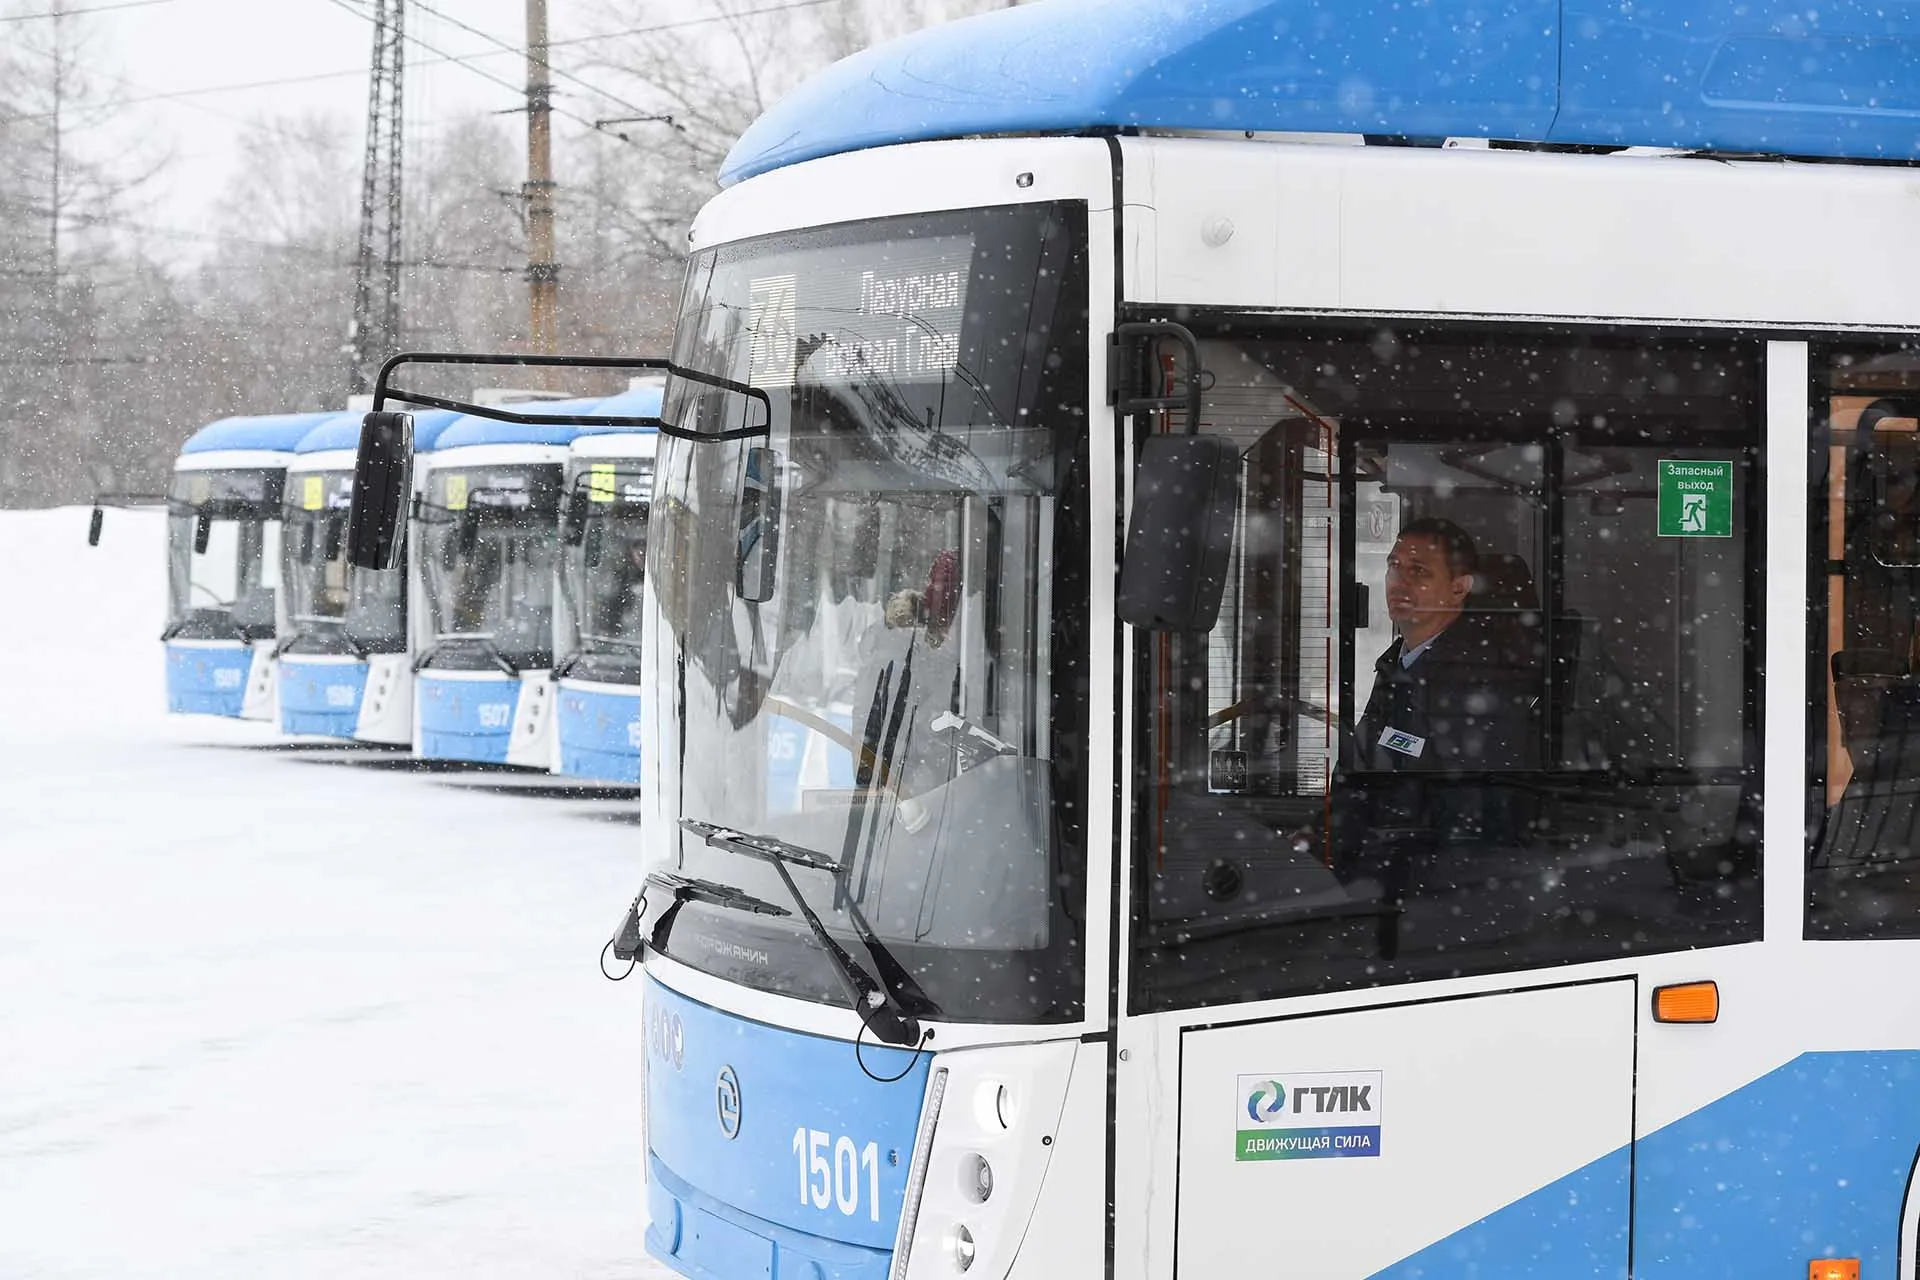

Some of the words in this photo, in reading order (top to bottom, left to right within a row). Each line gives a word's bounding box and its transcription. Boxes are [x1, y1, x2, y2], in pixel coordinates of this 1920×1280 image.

[857, 271, 959, 318] Лазурная
[1668, 463, 1723, 476] Запасный
[1678, 481, 1714, 491] выход
[1293, 1085, 1371, 1113] ГТЛК
[1246, 1136, 1330, 1153] ДВИЖУЩАЯ
[1334, 1135, 1371, 1148] СИЛА
[792, 1126, 880, 1222] 1501
